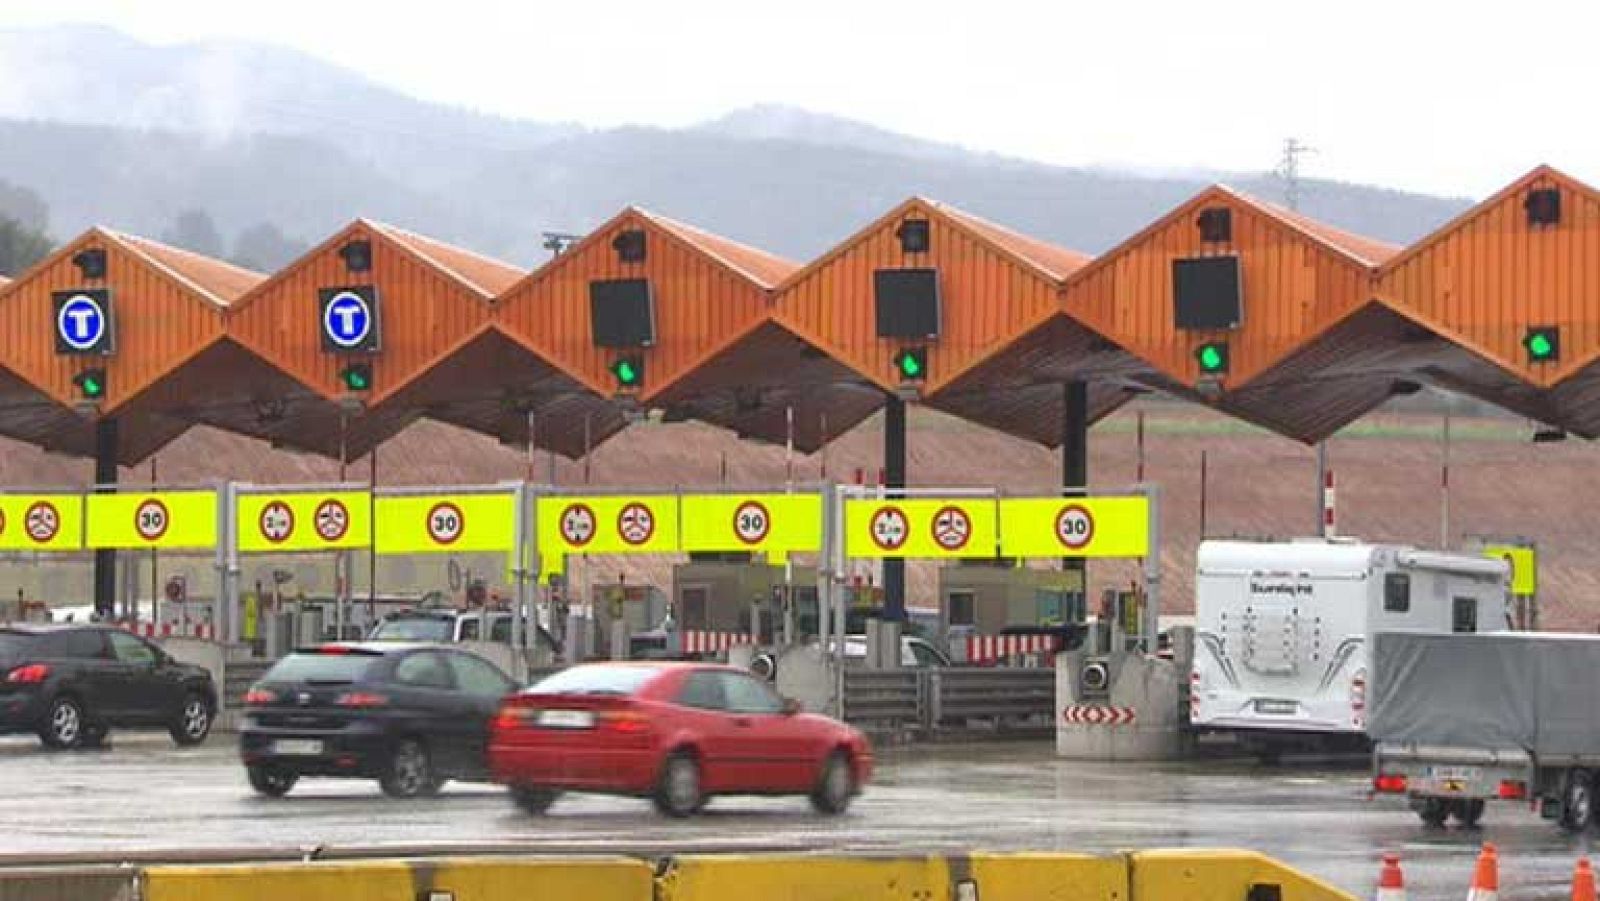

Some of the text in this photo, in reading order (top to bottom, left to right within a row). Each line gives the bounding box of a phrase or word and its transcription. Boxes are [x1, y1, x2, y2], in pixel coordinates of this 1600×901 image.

[68, 310, 94, 339] T
[334, 306, 360, 335] T
[141, 512, 162, 528] 30
[434, 515, 457, 531] 30
[741, 514, 763, 530] 30
[1063, 518, 1086, 535] 30
